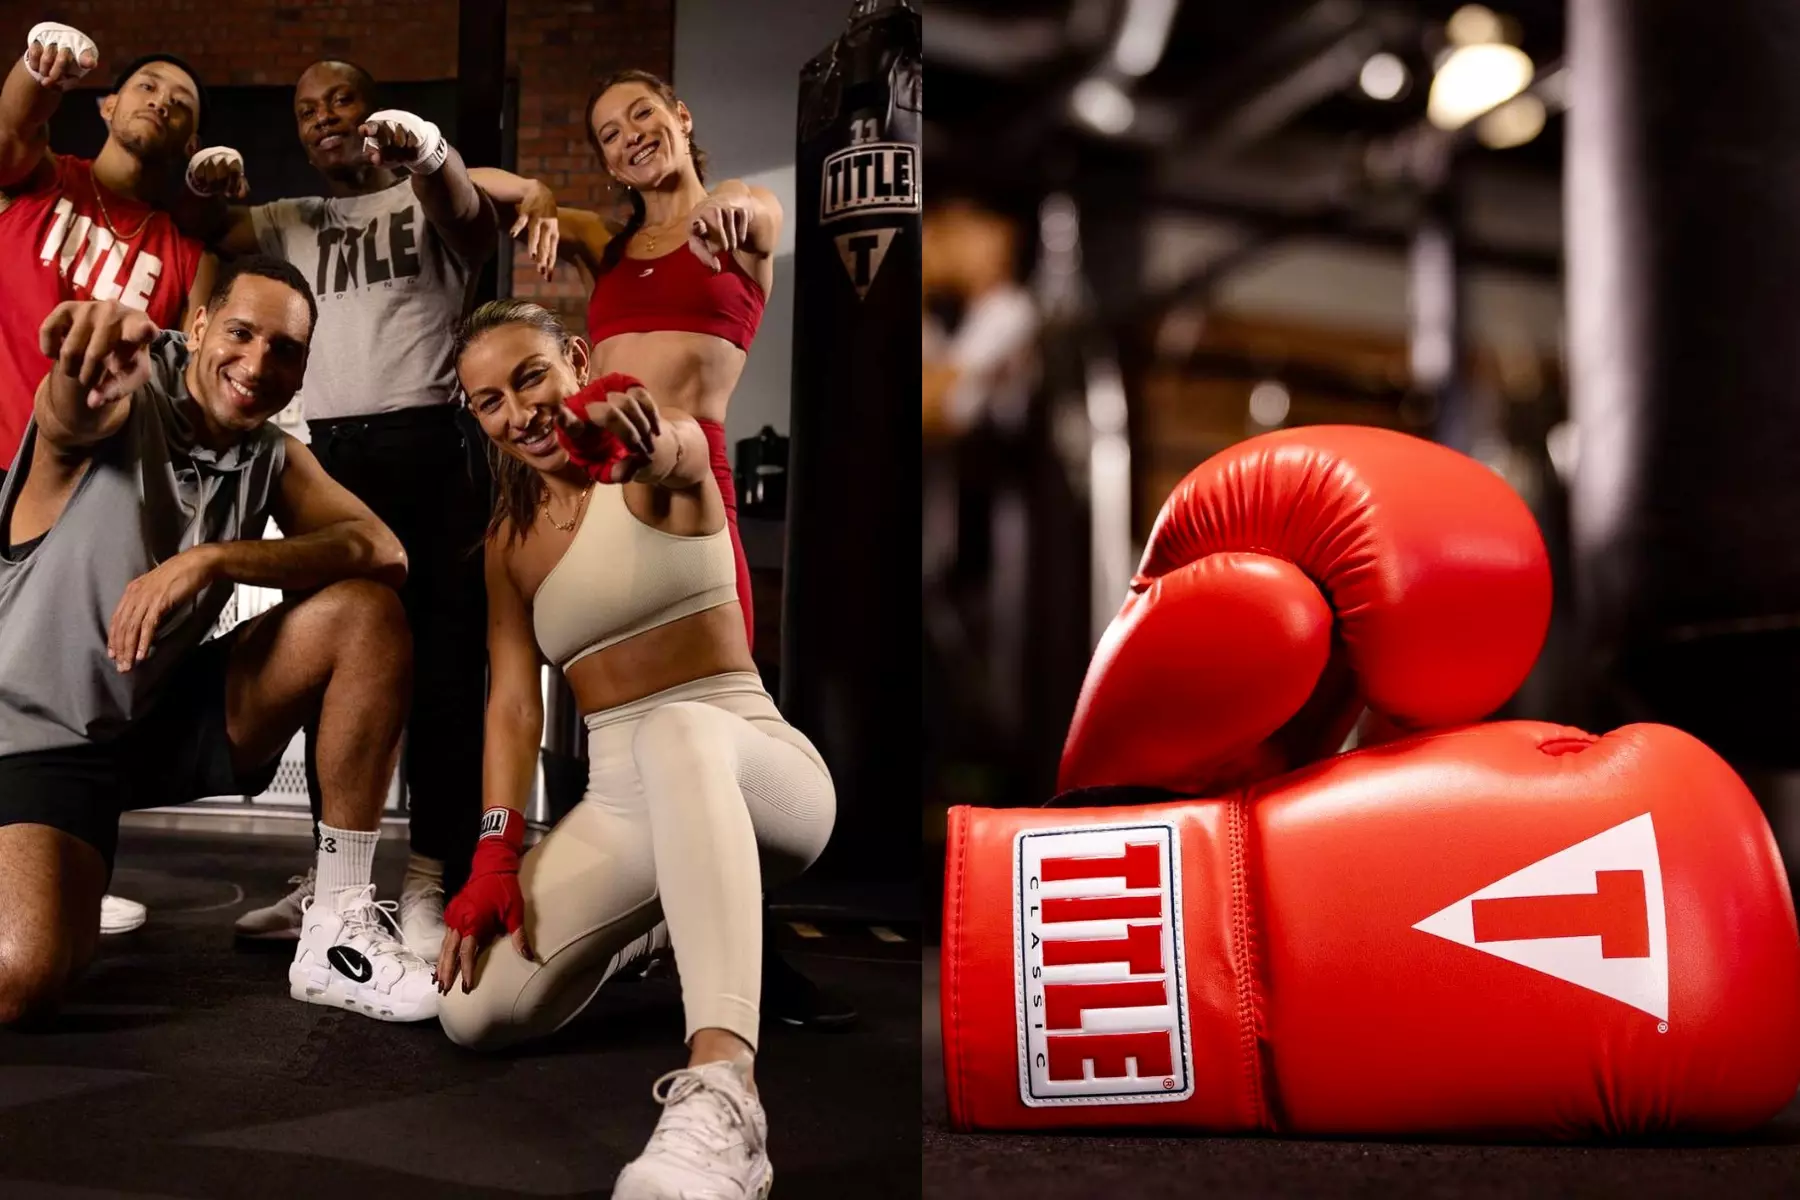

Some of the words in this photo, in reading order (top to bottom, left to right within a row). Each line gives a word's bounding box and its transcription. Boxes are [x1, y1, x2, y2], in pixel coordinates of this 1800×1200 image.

[850, 118, 881, 144] 11
[829, 151, 910, 208] TITLE
[40, 197, 163, 311] TITLE
[317, 205, 420, 295] TITLE
[848, 234, 879, 286] T
[1471, 869, 1651, 960] T
[1029, 875, 1046, 1069] CLASSIC
[1041, 841, 1173, 1081] TITLE
